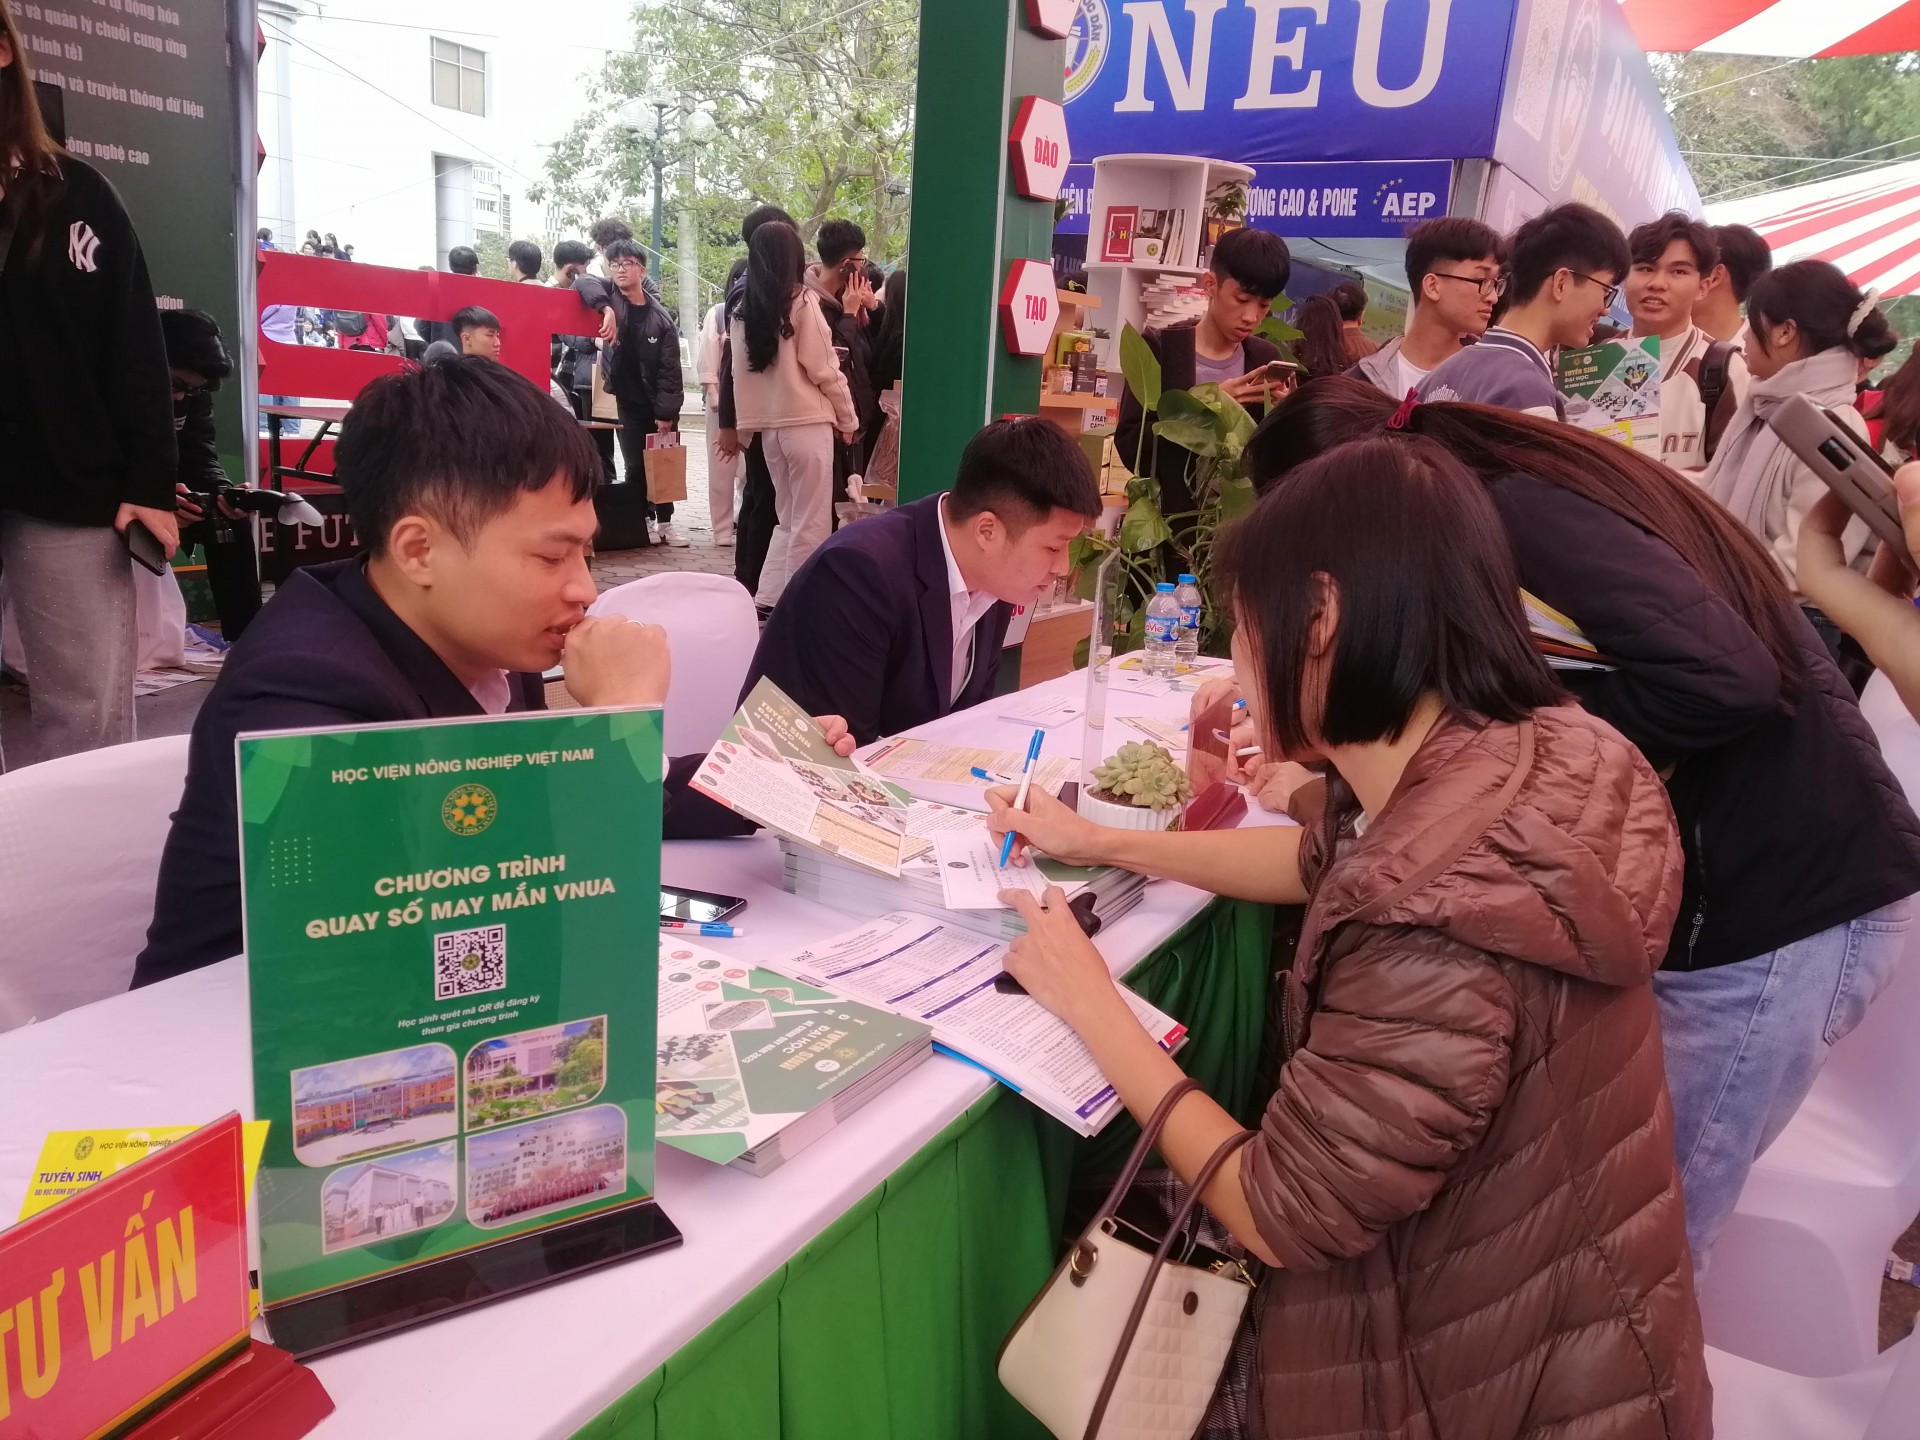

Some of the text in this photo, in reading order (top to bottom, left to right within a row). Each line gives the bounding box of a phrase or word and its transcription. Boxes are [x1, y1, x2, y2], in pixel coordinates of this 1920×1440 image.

[25, 3, 42, 21] và
[44, 9, 78, 30] quản
[80, 14, 93, 35] lý
[95, 21, 130, 43] chuỗi
[133, 31, 163, 53] cung
[165, 37, 188, 59] ứng
[1090, 13, 1104, 41] DÂN
[32, 34, 62, 57] kinh
[1114, 0, 1451, 111] NEU
[69, 76, 84, 93] và
[87, 80, 127, 102] truyền
[130, 88, 163, 111] thông
[183, 99, 204, 119] liệu
[94, 143, 125, 163] nghệ
[128, 149, 150, 166] cao
[1034, 135, 1059, 168] ĐÀO
[1279, 187, 1305, 217] CAO
[1307, 189, 1319, 217] &
[1321, 187, 1358, 217] POHE
[1381, 192, 1436, 216] AEP
[68, 220, 101, 273] NY
[1025, 295, 1047, 325] TẠO
[757, 707, 795, 741] ĐẠI HỌC
[760, 700, 789, 729] TUYỂN
[790, 726, 812, 748] SINH
[332, 748, 595, 785] HỌC VIỆN NÔNG NGHIỆP VIỆT NAM
[374, 854, 566, 897] CHƯƠNG TRÌNH
[305, 877, 616, 939] QUAY SỐ MAY MẮN VNUA
[397, 1019, 417, 1029] Học
[418, 1013, 438, 1025] sinh
[440, 1010, 460, 1021] quét
[478, 1004, 492, 1014] QR
[506, 996, 528, 1007] đăng
[529, 994, 540, 1003] ký
[421, 1010, 519, 1036] tham gia chương trình
[782, 1025, 831, 1054] ĐẠI HỌC
[808, 1030, 849, 1053] TUYỂN
[99, 1138, 172, 1151] HỌC VIỆN NÔNG NGHIỆP
[39, 1167, 102, 1183] TUYỂN SINH
[79, 1189, 197, 1362] VẤN
